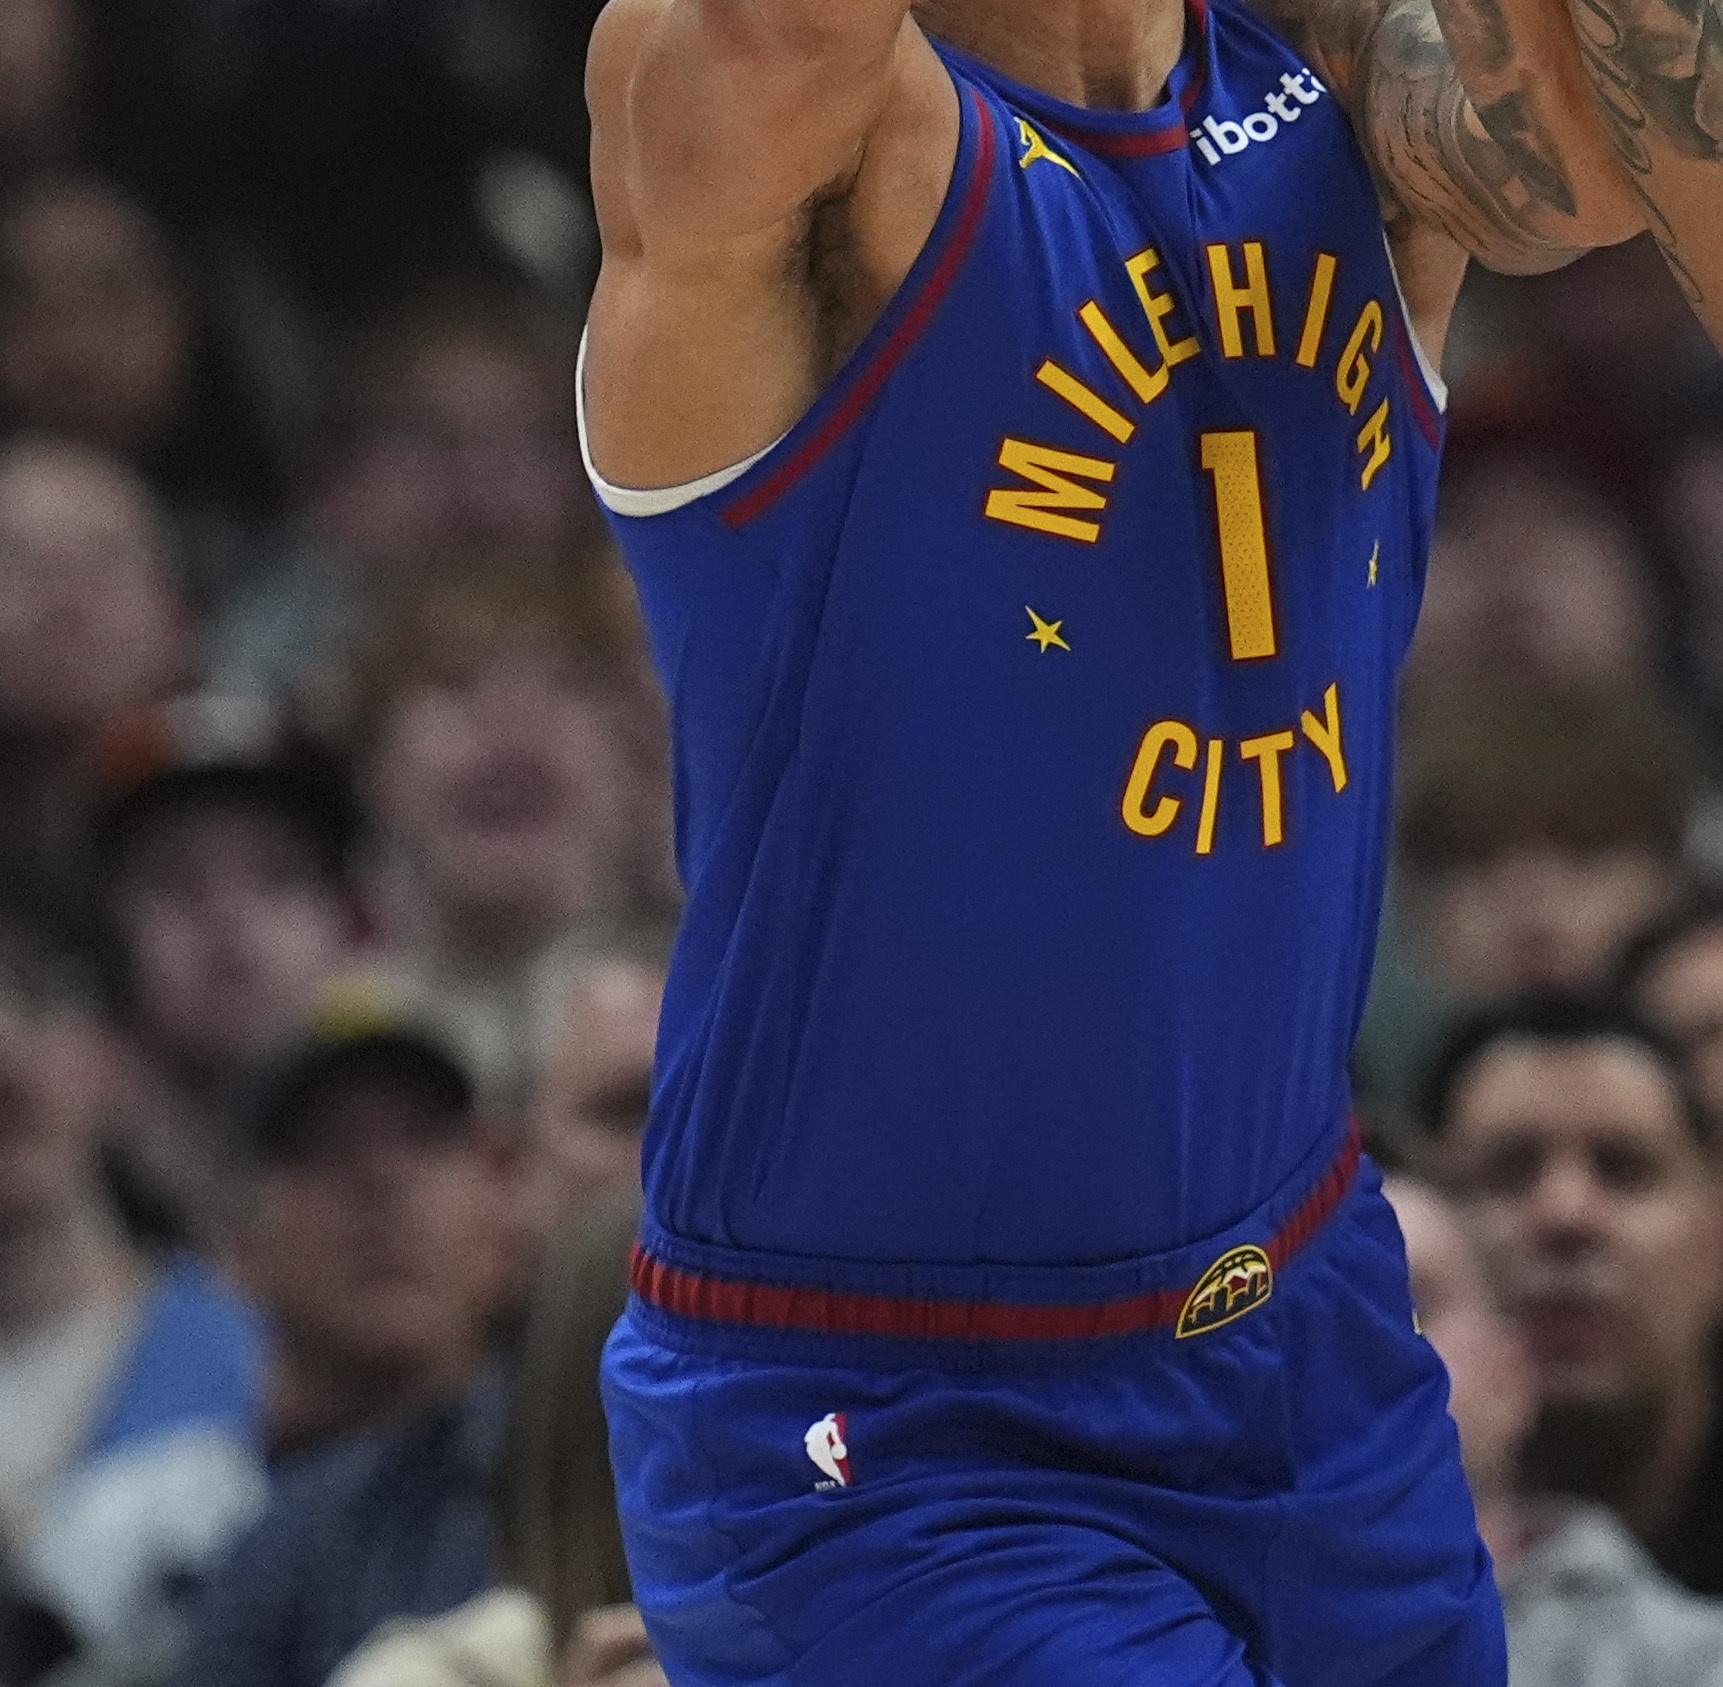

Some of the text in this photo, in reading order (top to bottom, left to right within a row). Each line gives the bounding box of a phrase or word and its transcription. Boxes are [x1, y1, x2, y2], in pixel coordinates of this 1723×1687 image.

[983, 240, 1392, 544] MILE HIGH
[1199, 429, 1277, 660] 1
[1120, 684, 1349, 855] CITY
